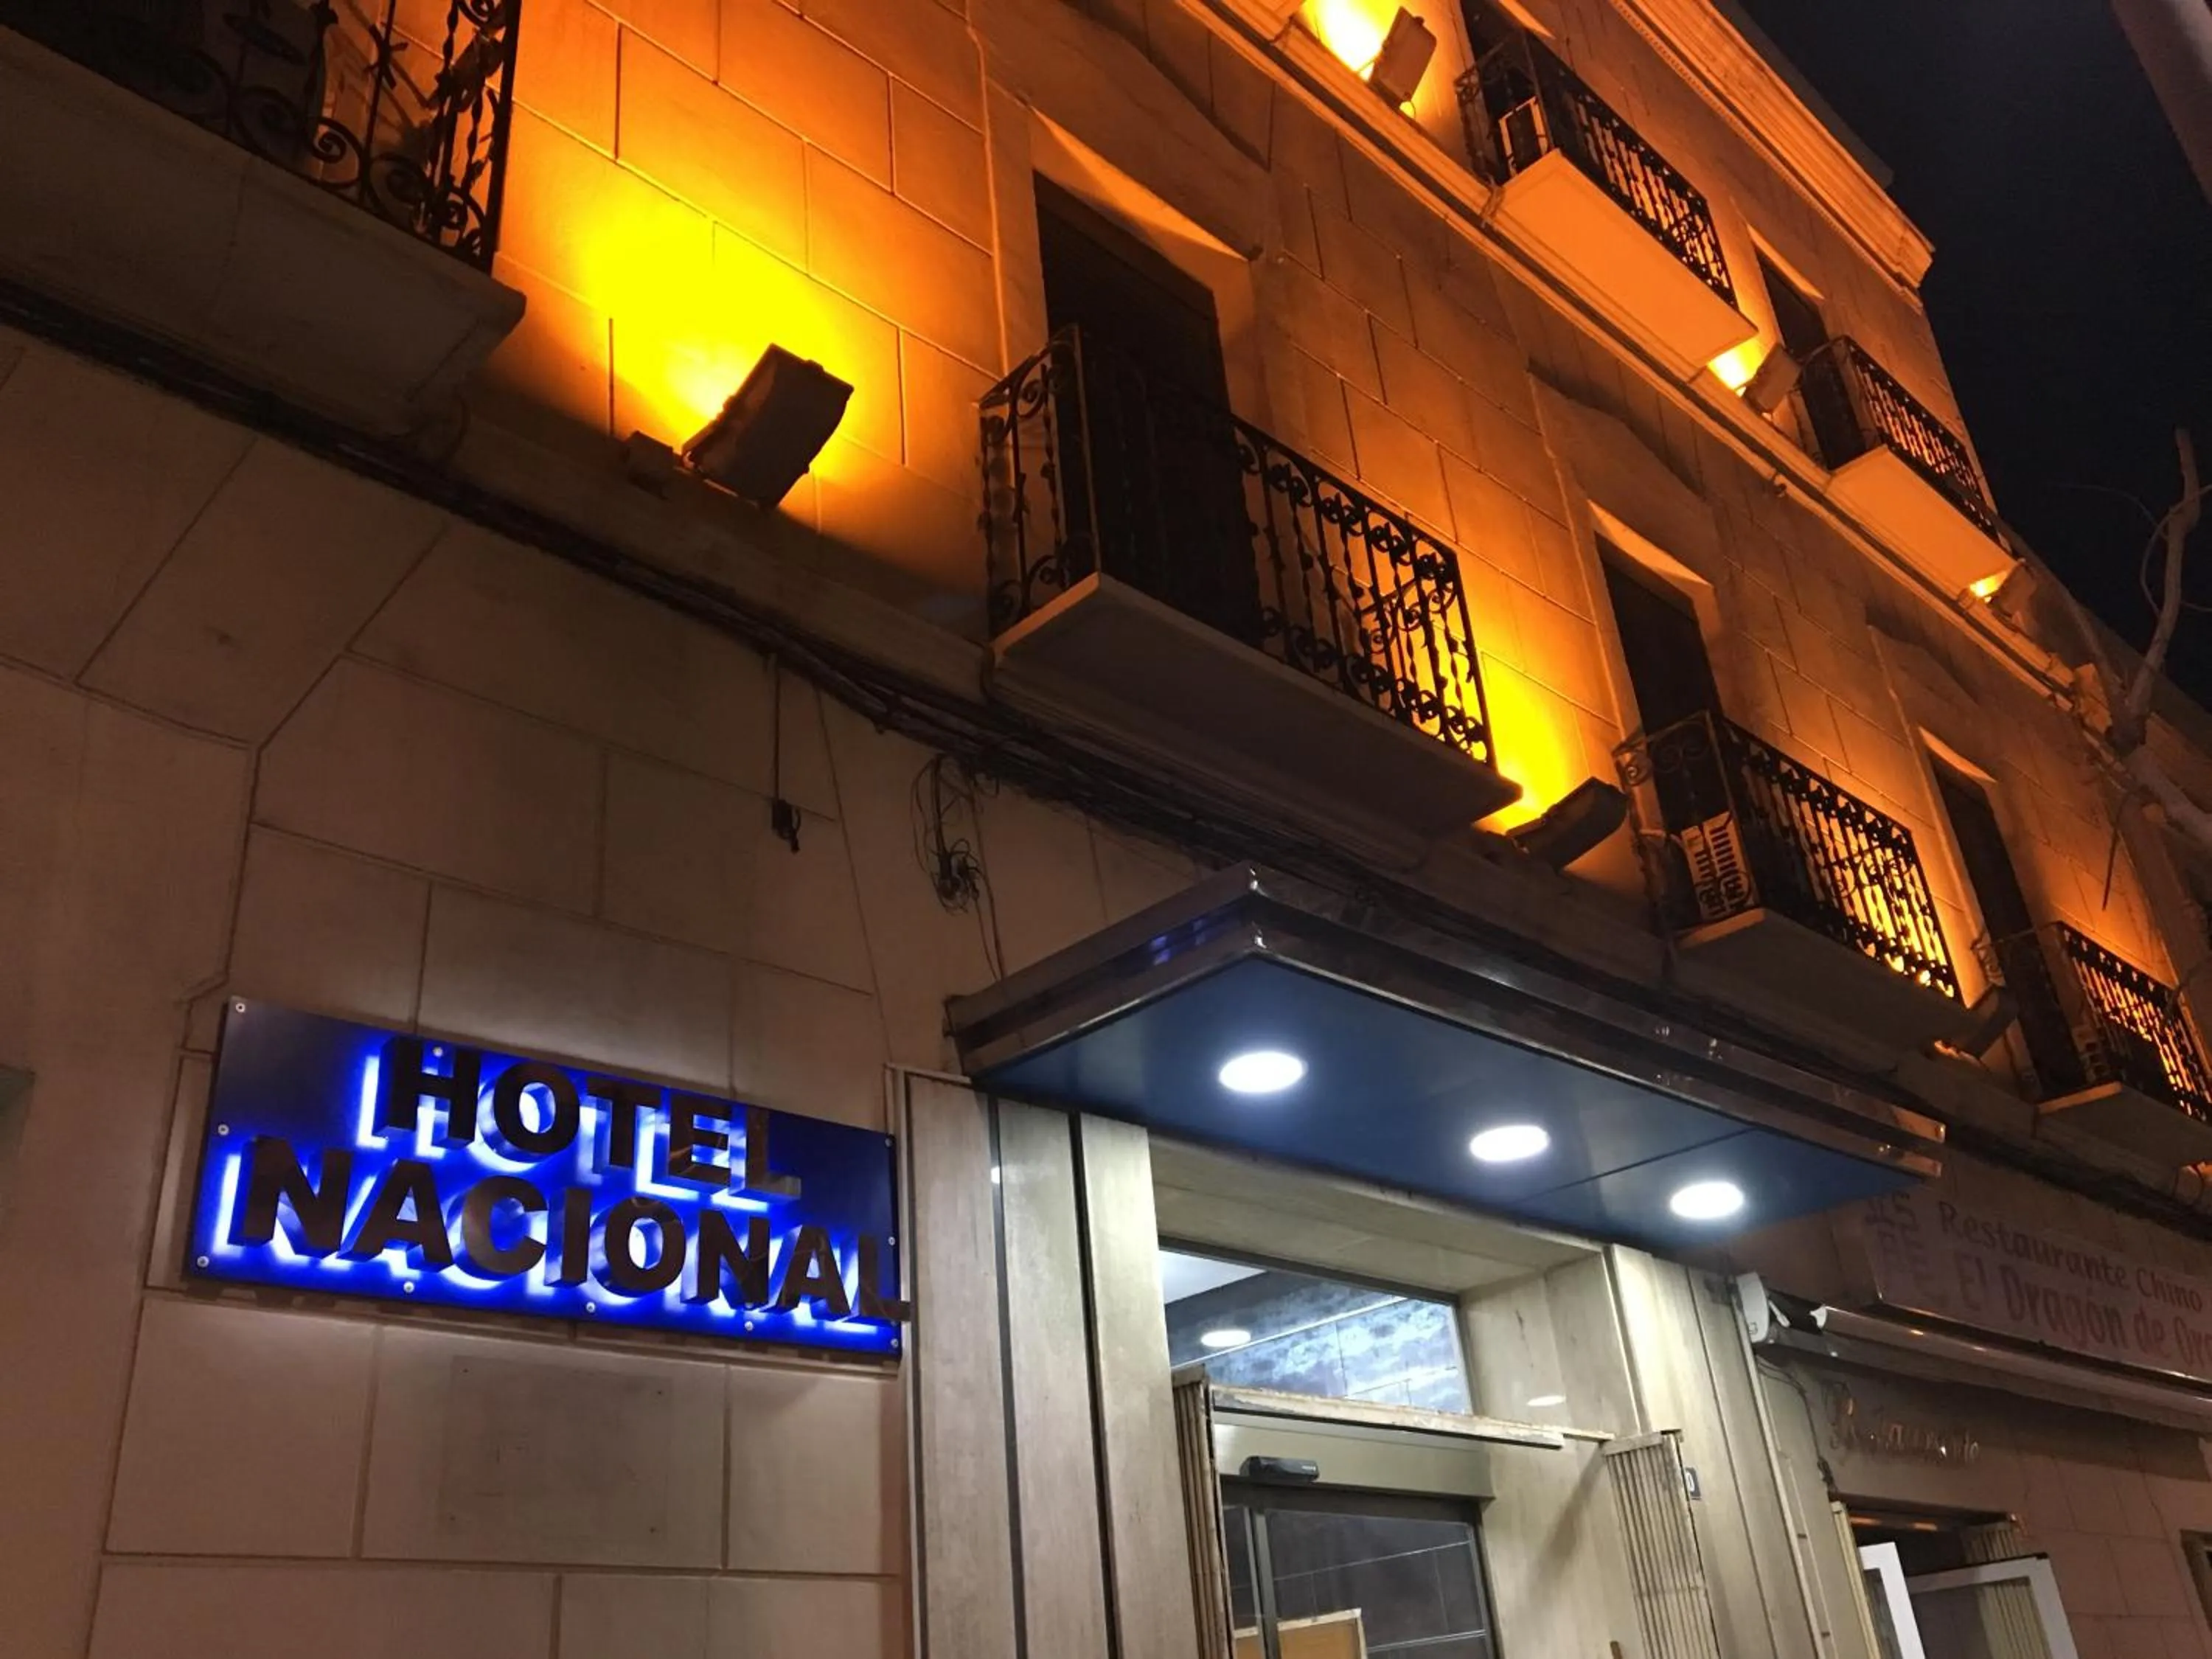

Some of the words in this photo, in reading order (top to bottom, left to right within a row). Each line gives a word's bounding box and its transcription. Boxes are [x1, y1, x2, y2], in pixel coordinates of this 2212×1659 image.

[375, 1036, 801, 1205] HOTEL
[229, 1134, 911, 1324] NACIONAL
[1938, 1200, 2131, 1291] Restaurante
[2136, 1267, 2203, 1314] Chino
[1953, 1251, 1990, 1312] El
[2133, 1305, 2171, 1358] de
